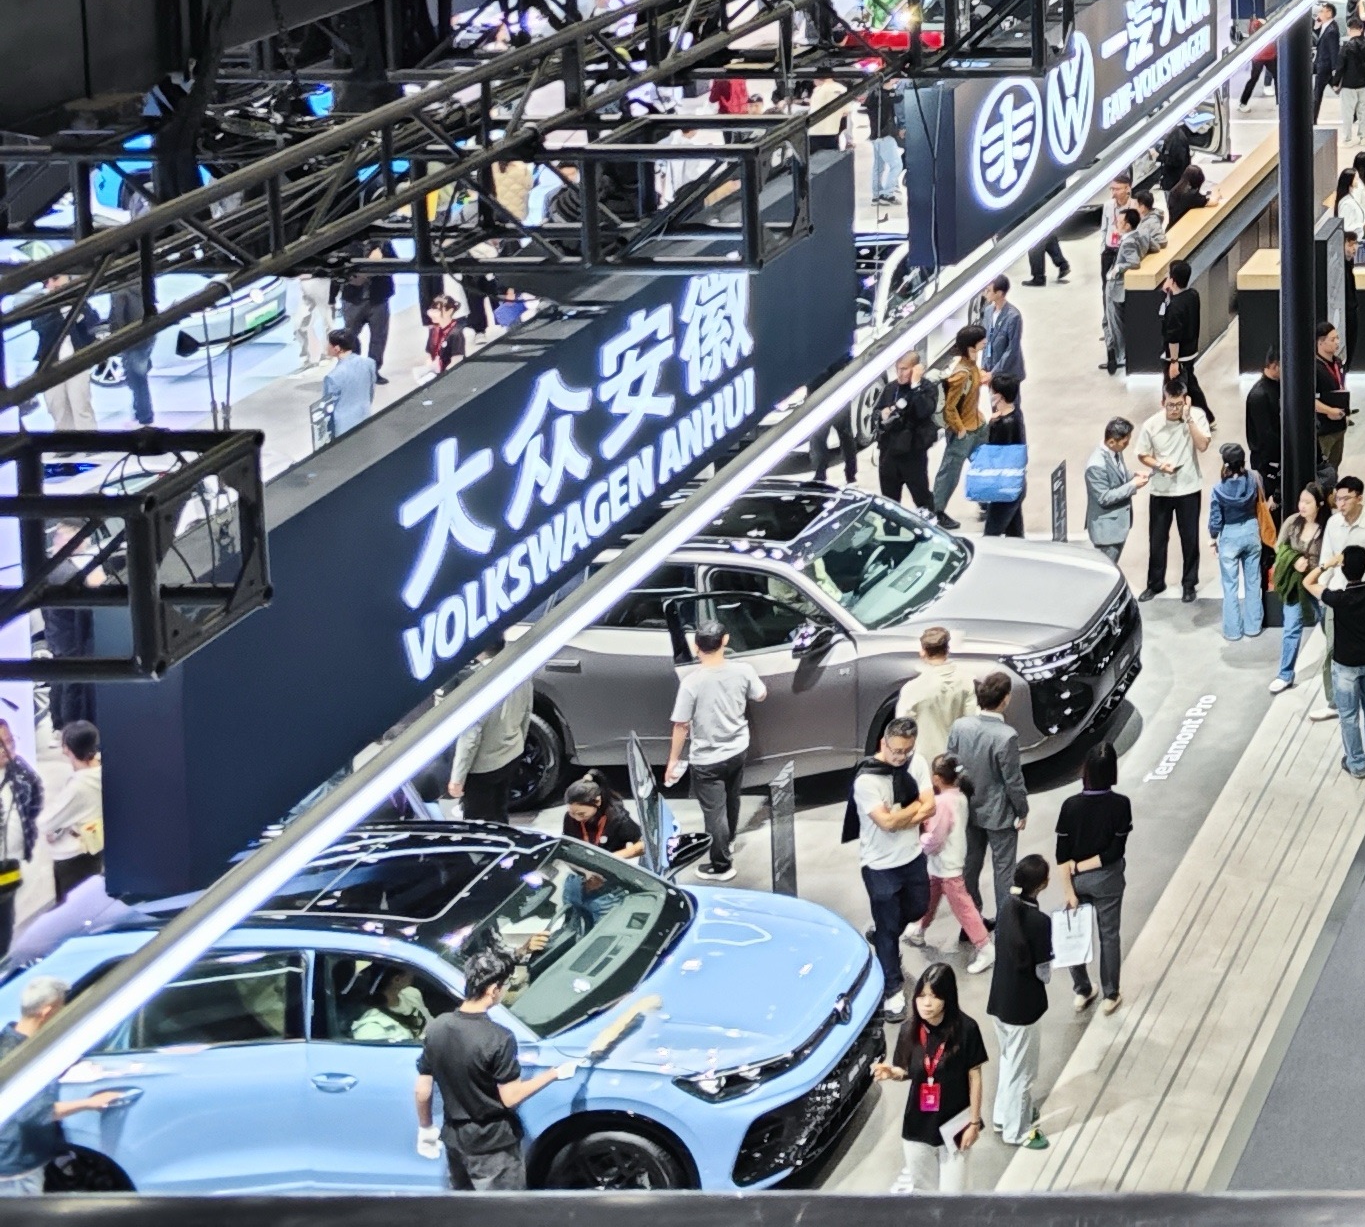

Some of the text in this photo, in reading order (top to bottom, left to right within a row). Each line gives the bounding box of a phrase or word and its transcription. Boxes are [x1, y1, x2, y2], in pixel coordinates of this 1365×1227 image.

[1101, 24, 1211, 129] FAW-VOLKSWAGEN
[400, 271, 756, 610] 大众安徽
[402, 367, 757, 679] VOLKSWAGEN ANHUI
[1143, 694, 1217, 783] Teramont Pro
